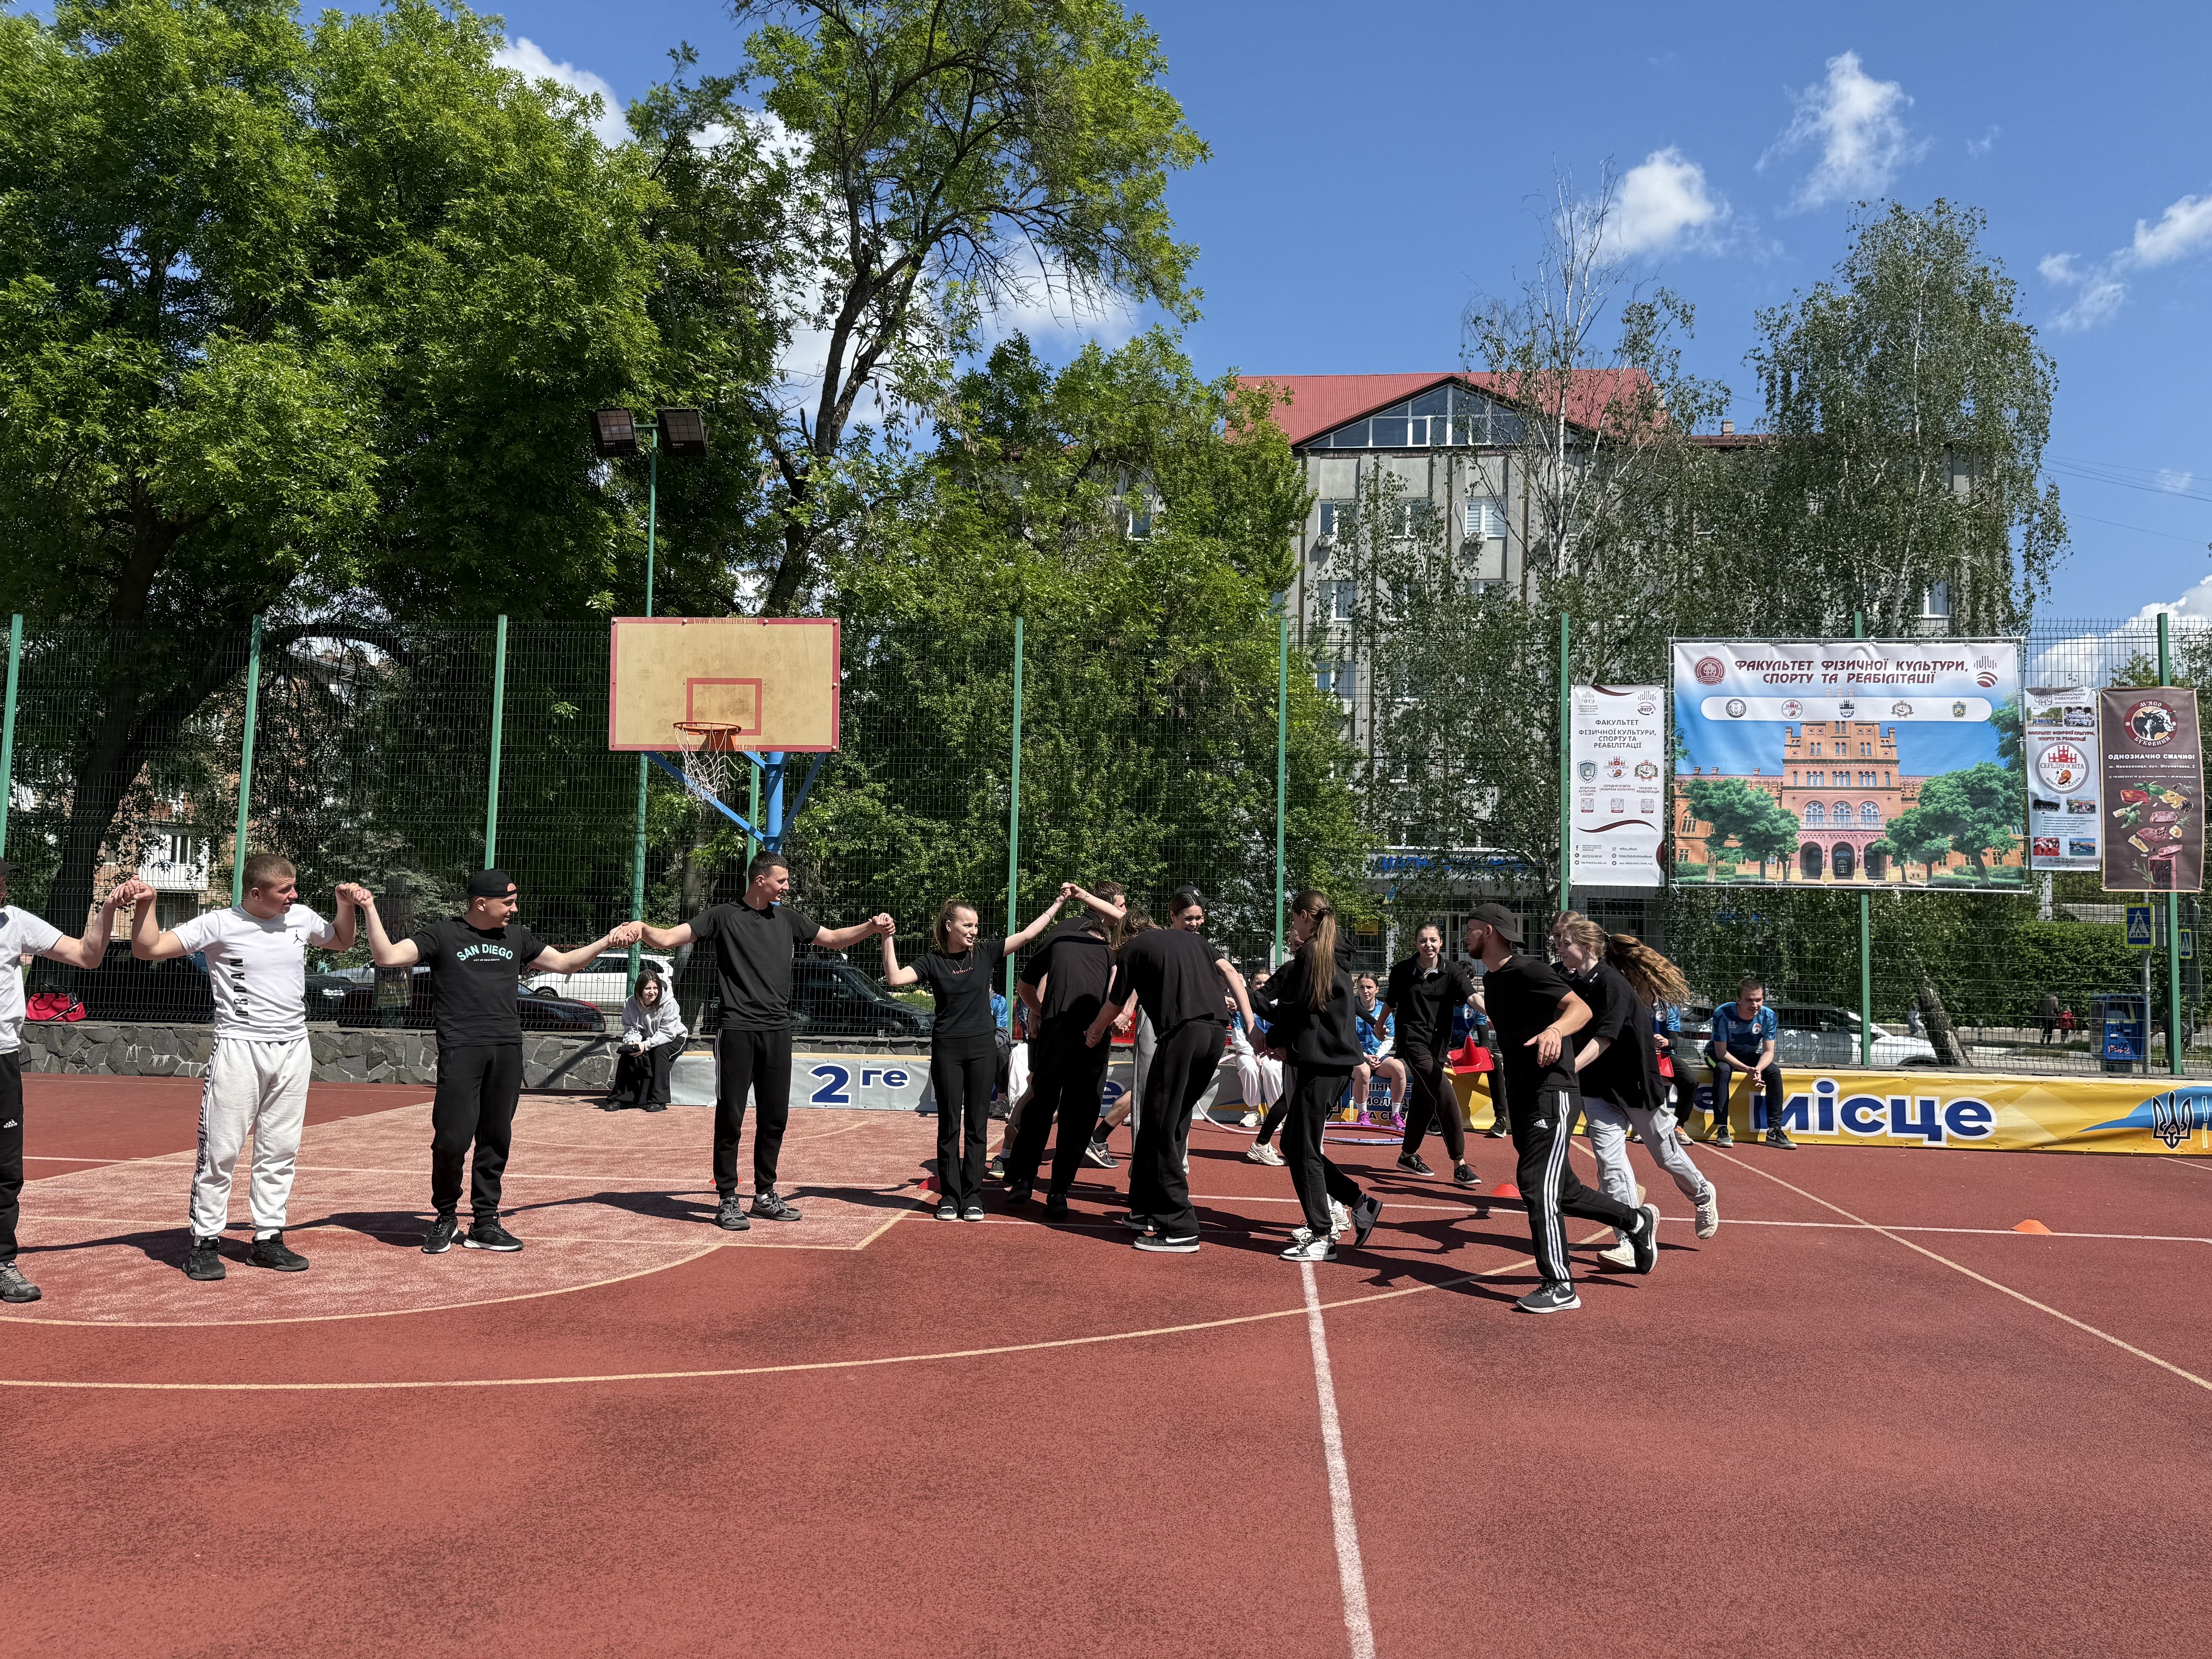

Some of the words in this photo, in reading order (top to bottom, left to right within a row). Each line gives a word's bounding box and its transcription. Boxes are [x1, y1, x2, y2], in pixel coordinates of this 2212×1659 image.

[1735, 660, 1814, 671] ФАКУЛЬТЕТ
[1821, 658, 1889, 671] ФІЗИЧНОЇ
[1897, 661, 1968, 672] КУЛЬТУРИ,
[1763, 674, 1814, 684] СПОРТУ
[1821, 674, 1838, 684] ТА
[1847, 672, 1936, 684] РЕАБІЛІТАЦІЇ
[2134, 736, 2171, 747] БУКОВИНИ
[457, 945, 479, 961] SAN
[482, 944, 513, 960] DIEGO
